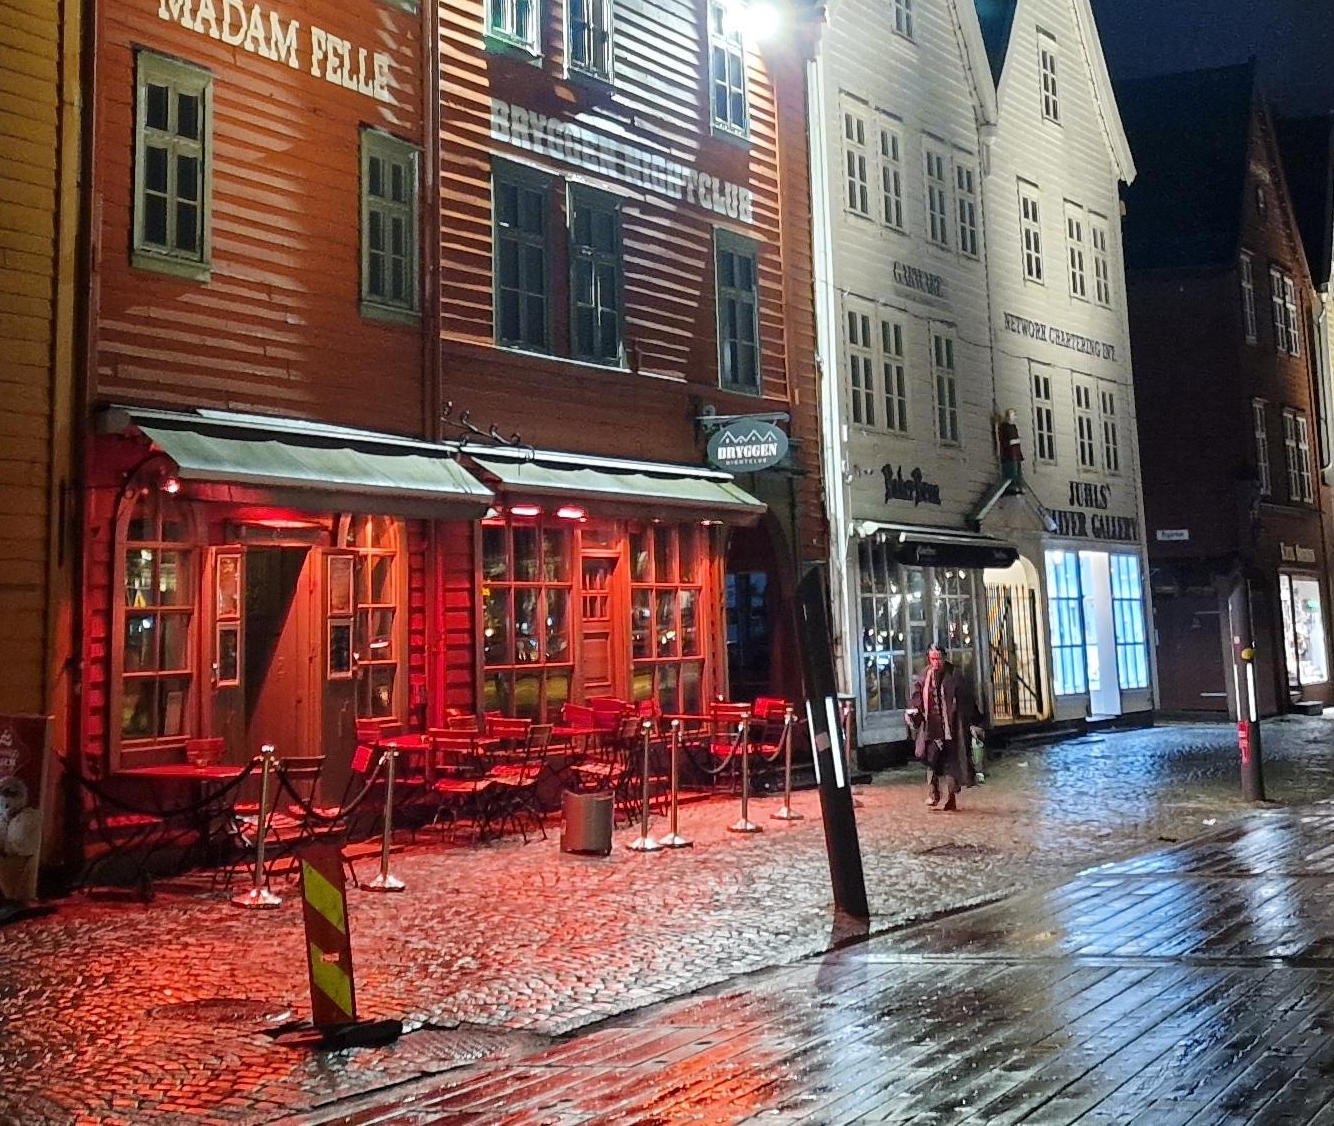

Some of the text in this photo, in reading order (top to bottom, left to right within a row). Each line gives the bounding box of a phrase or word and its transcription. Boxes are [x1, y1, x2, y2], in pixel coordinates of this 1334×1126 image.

[310, 25, 392, 104] FELLE
[490, 97, 754, 225] BRYGGEN NIGHTCLUB
[1003, 311, 1047, 342] NETWORK
